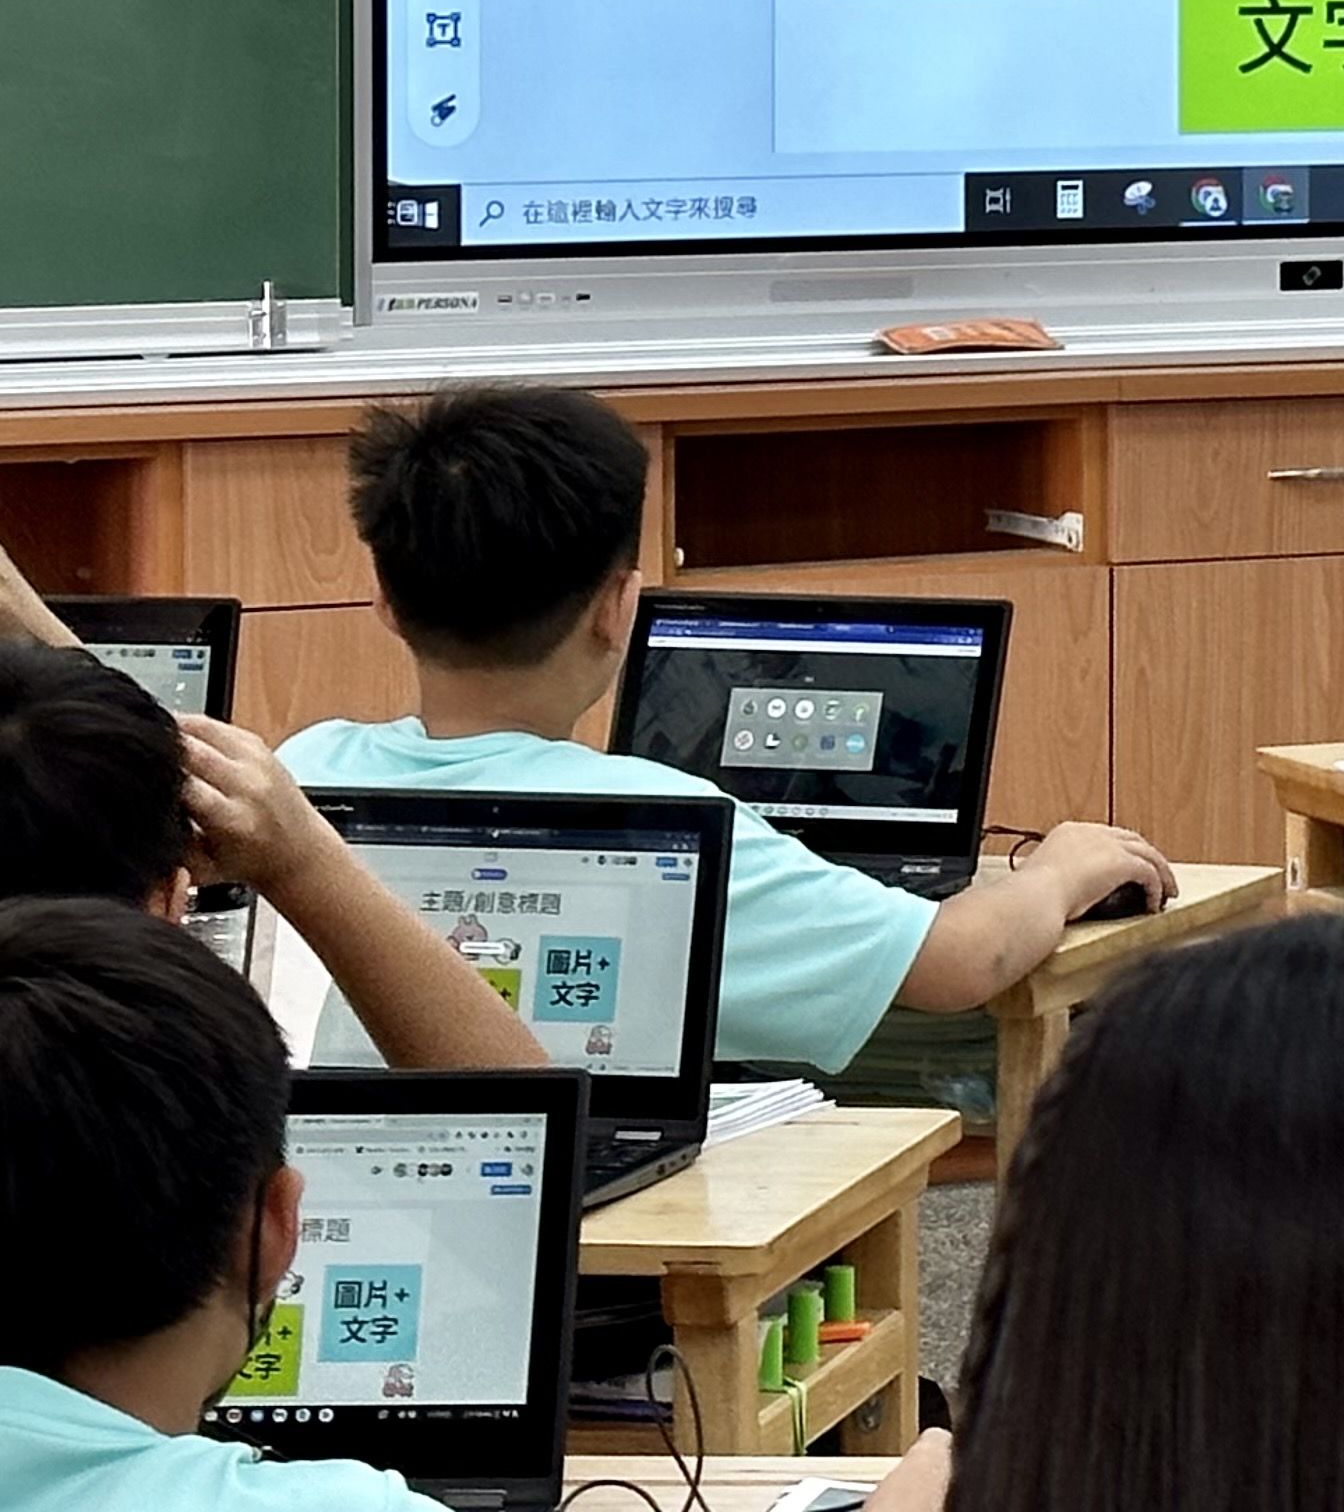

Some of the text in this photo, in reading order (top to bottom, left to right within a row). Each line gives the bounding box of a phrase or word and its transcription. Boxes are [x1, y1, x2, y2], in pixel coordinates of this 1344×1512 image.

[420, 890, 561, 916] 主題/創意標題
[546, 949, 611, 976] 圖片+
[549, 982, 601, 1008] 文字
[334, 1280, 410, 1310] 圖片+
[340, 1316, 399, 1345] 文字
